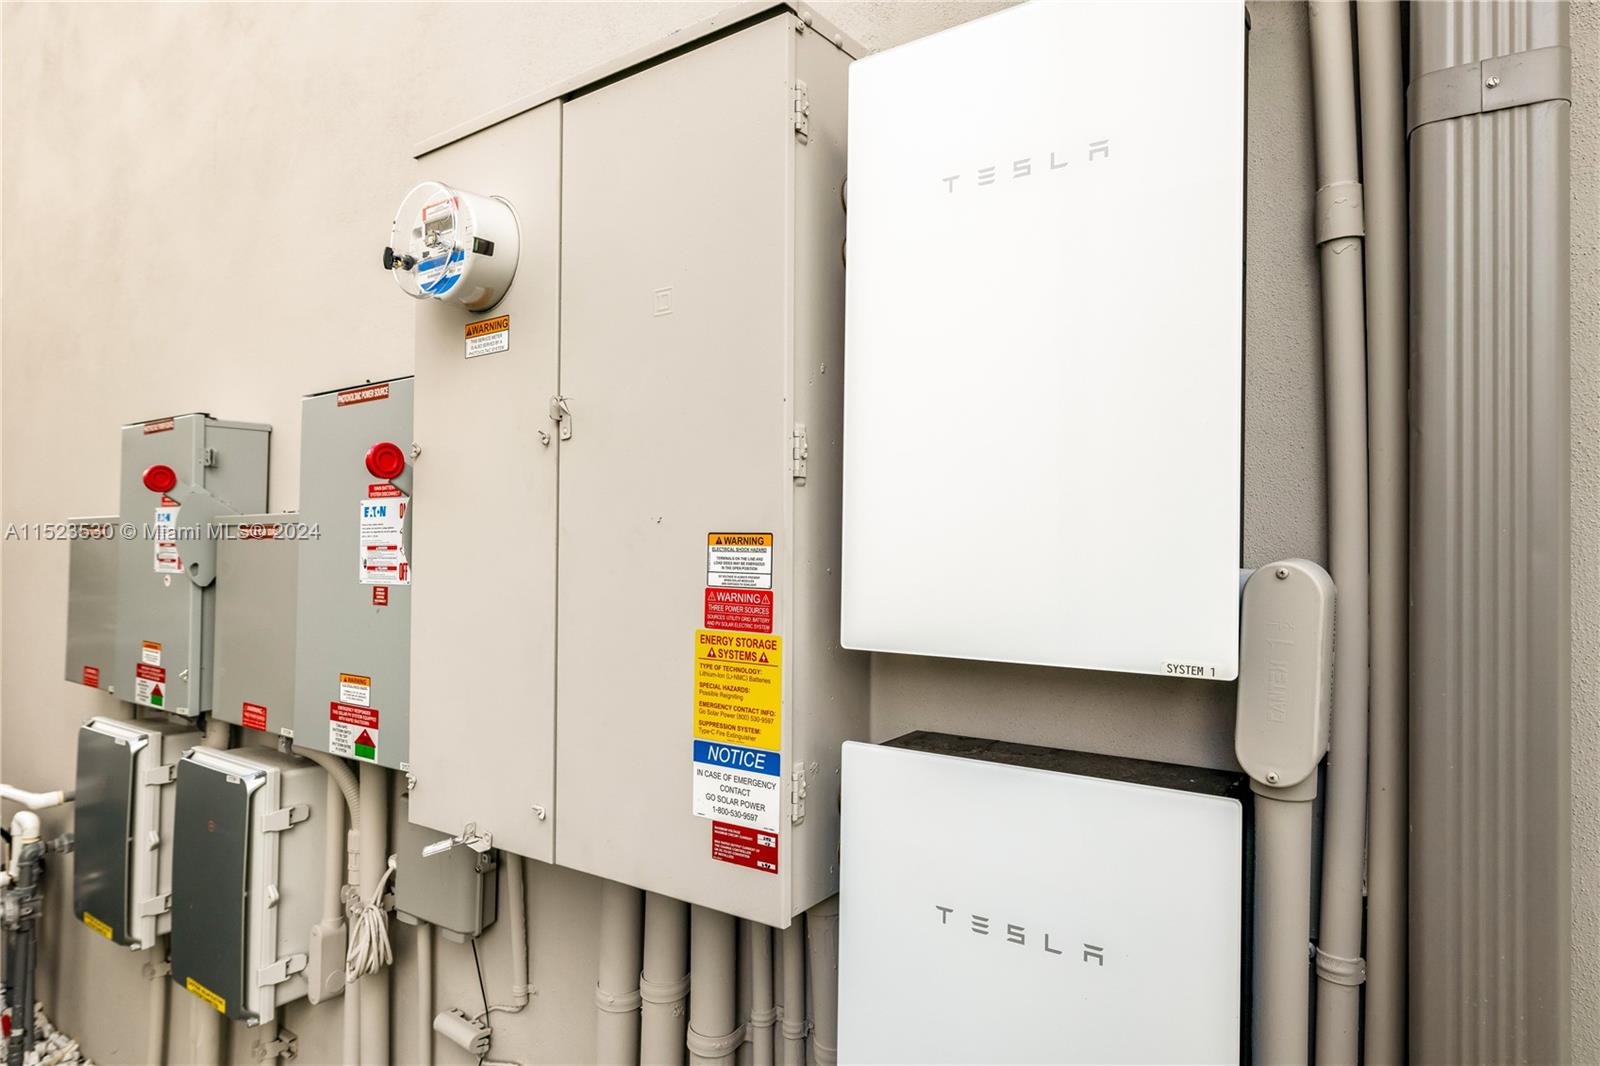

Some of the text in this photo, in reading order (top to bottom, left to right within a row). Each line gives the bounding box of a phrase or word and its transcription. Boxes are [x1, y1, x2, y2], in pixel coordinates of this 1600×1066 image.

[942, 139, 1110, 193] TESLA
[472, 319, 508, 334] WARNING
[724, 536, 764, 546] WARNING
[717, 592, 760, 604] WARNING
[700, 634, 777, 650] ENERGY STORAGE
[718, 649, 757, 661] SYSTEMS
[723, 666, 761, 674] TECHNOLOGY:
[1166, 663, 1215, 677] SYSTEM 1
[722, 684, 750, 693] HAZARDS:
[699, 700, 732, 711] EMERGENCY
[733, 705, 760, 714] CONTACT
[699, 720, 761, 734] SUPPRESSION SYSTEM:
[726, 731, 756, 741] Extinguisher
[707, 745, 766, 769] NOTICE
[704, 770, 721, 780] CASE
[723, 773, 732, 782] OF
[733, 775, 776, 790] EMERGENCY
[720, 784, 750, 797] CONTACT
[706, 792, 766, 812] GO SOLAR POWER
[712, 806, 758, 822] 1-800-530-9597
[936, 905, 1104, 966] TESLA
